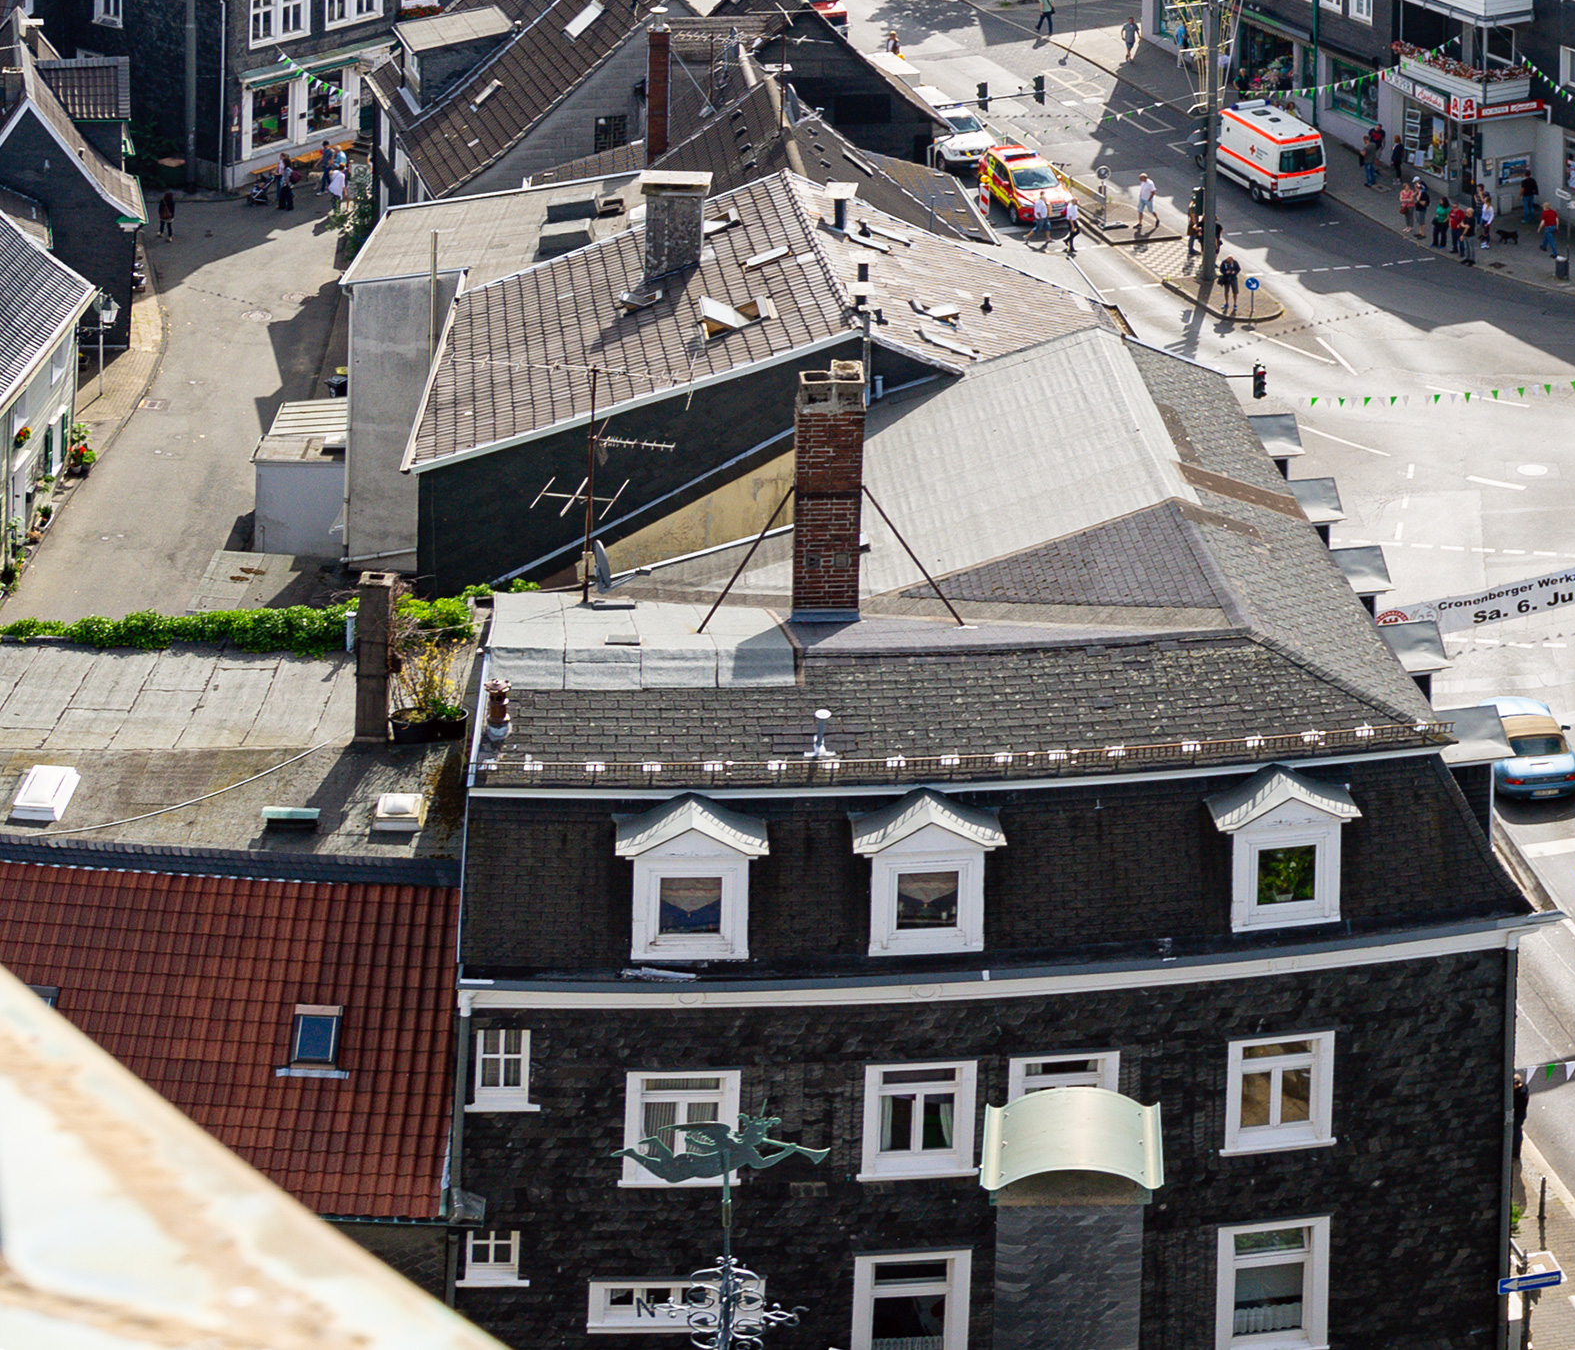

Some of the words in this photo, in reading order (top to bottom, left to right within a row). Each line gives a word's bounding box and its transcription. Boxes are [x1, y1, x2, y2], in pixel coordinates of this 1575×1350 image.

[1438, 583, 1534, 611] Cronenberger
[1473, 609, 1509, 624] Sa.
[1517, 599, 1538, 613] 6.
[635, 1295, 656, 1318] N
